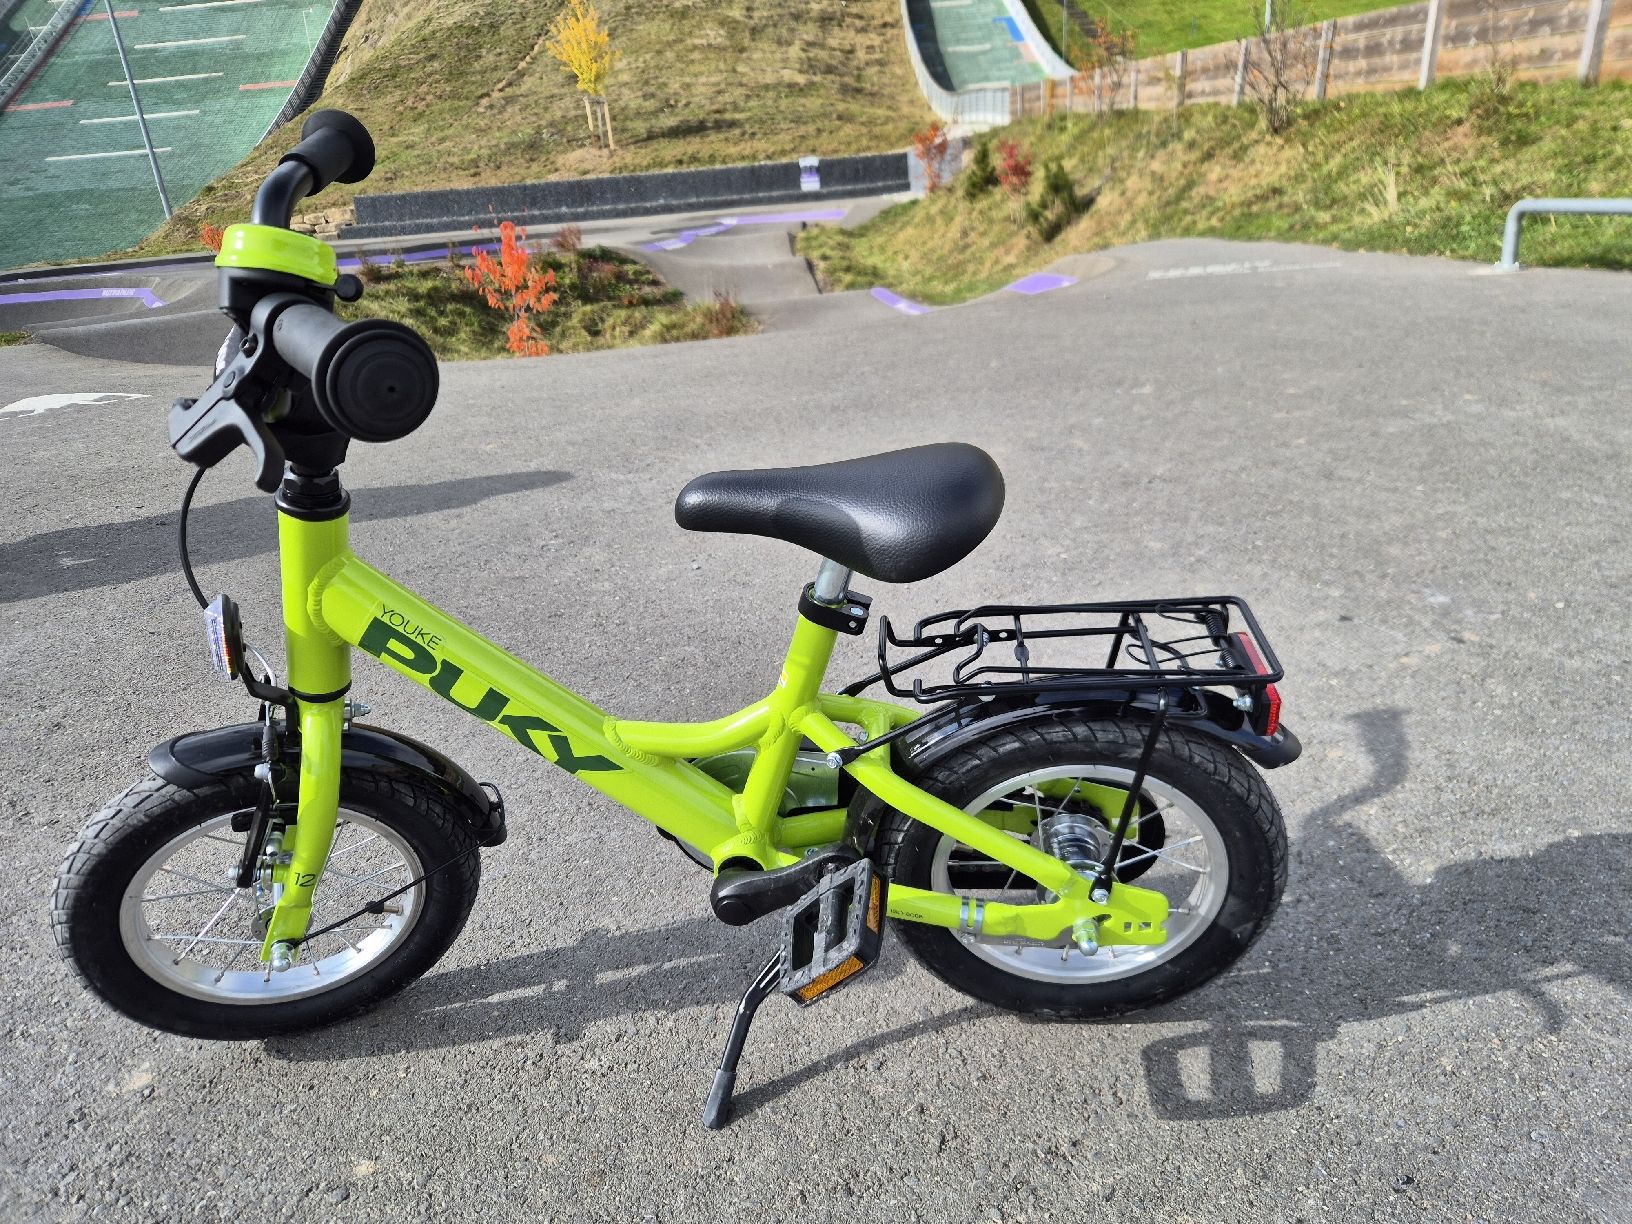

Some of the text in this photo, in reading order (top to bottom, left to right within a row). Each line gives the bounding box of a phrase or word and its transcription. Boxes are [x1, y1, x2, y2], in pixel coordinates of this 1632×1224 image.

[381, 604, 443, 651] YOUKE
[358, 617, 624, 774] PUKY
[294, 872, 316, 887] 12
